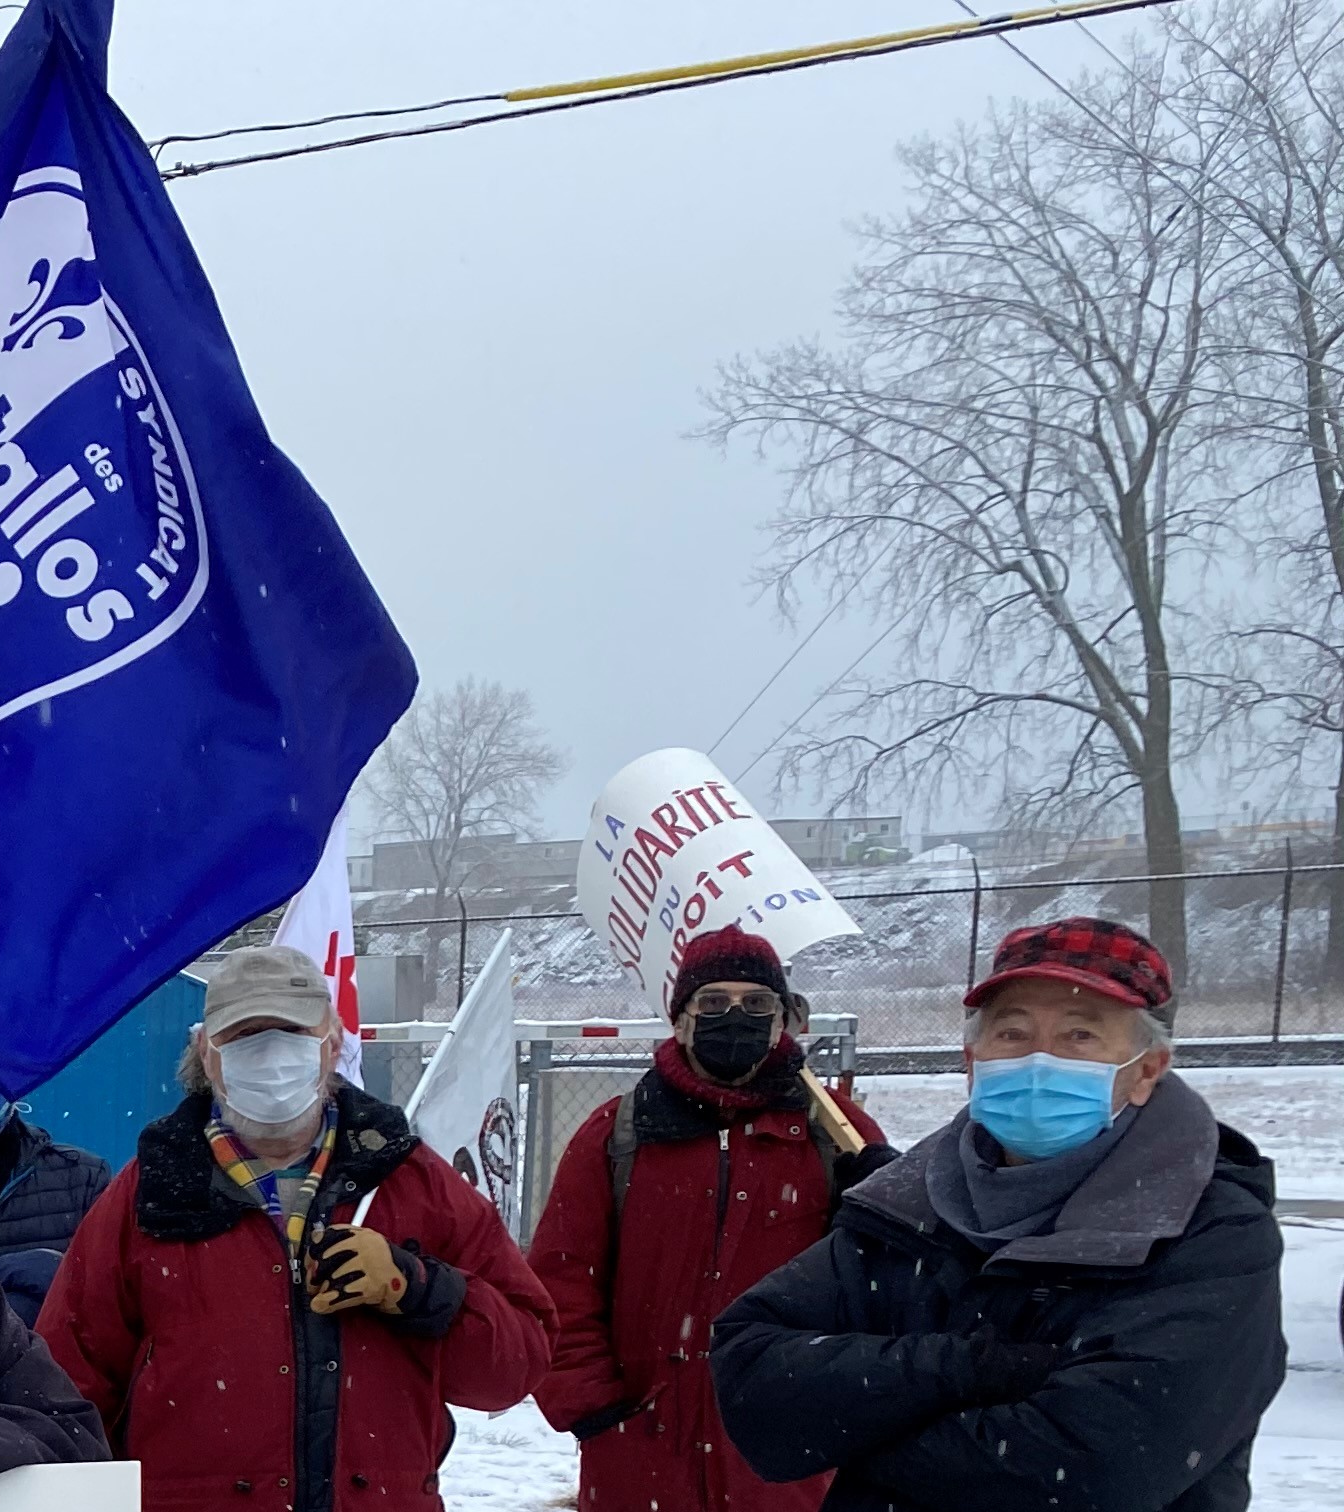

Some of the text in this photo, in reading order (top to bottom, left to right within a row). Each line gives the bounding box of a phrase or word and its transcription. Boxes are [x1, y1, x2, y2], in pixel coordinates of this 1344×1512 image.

[83, 442, 124, 495] des
[118, 366, 188, 603] SYNDICAT
[595, 814, 625, 862] LA
[659, 884, 681, 933] DU
